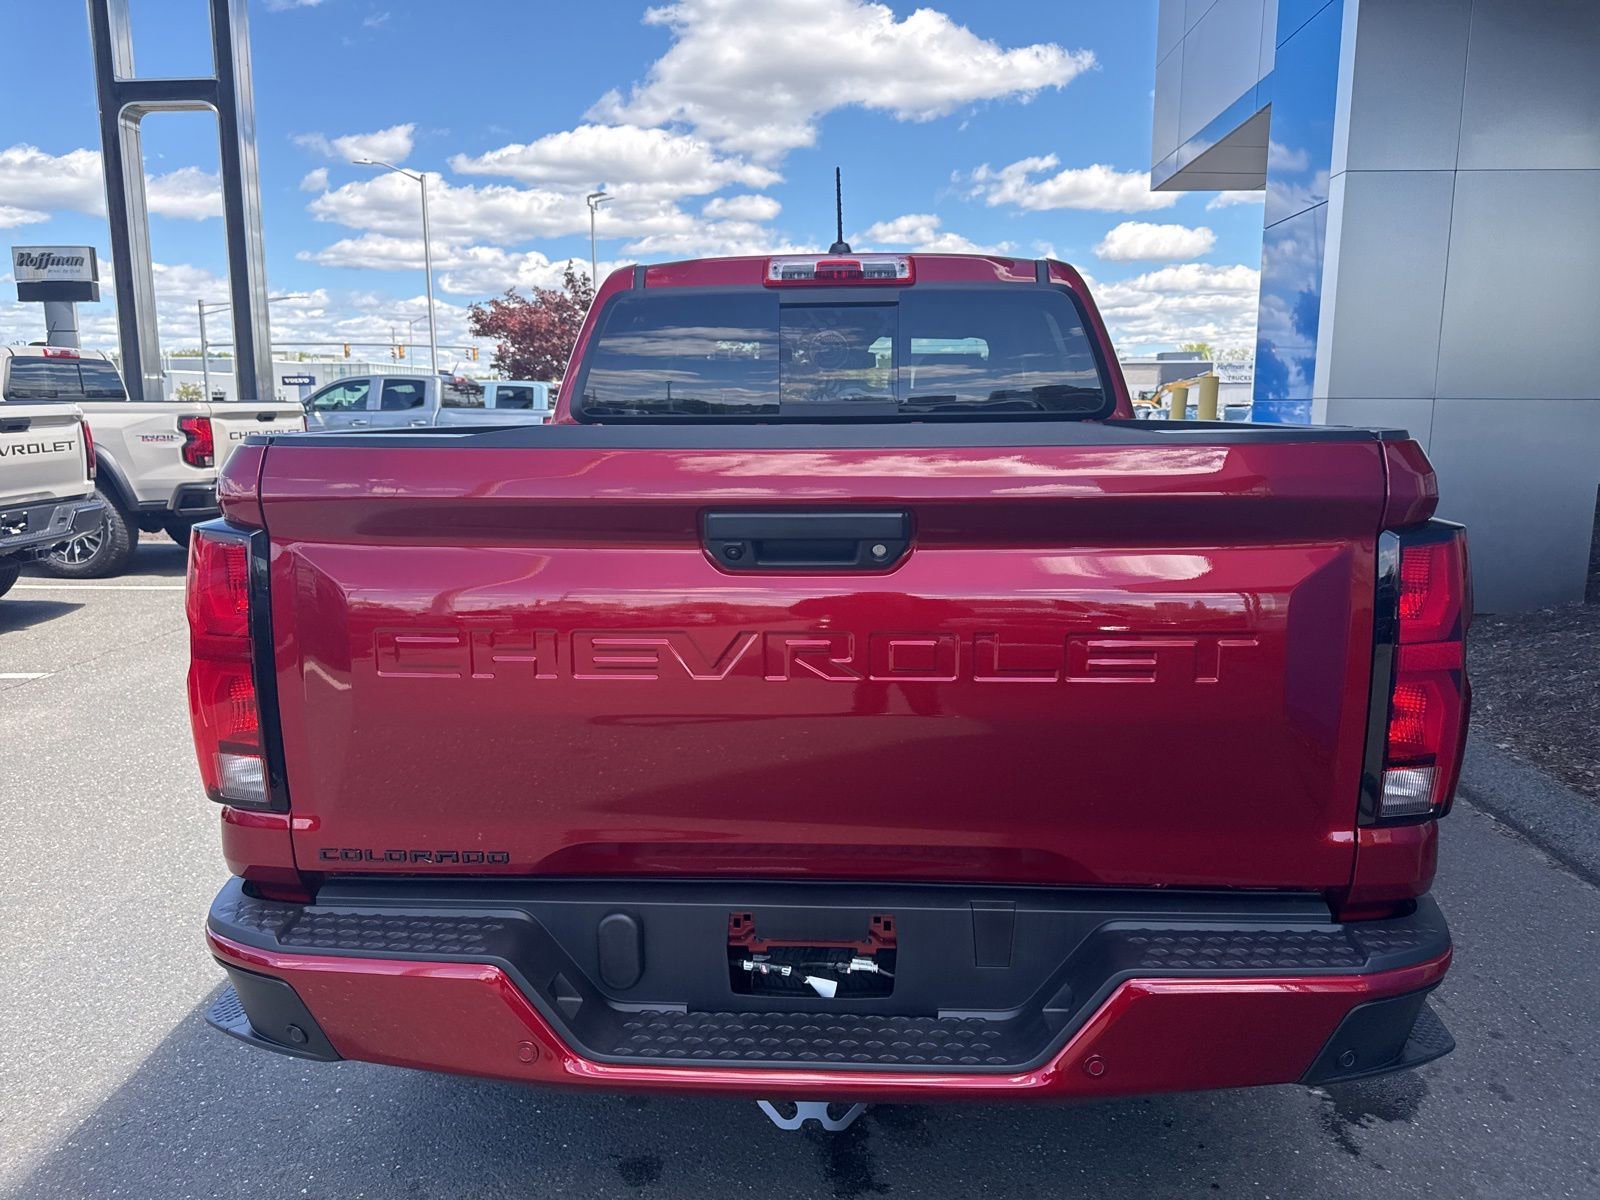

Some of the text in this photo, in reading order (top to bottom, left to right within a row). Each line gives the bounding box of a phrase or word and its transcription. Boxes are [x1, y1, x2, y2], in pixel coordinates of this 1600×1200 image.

[16, 252, 84, 270] Hoffman
[374, 627, 1259, 683] CHEVROLET
[319, 847, 510, 864] COLORADO
